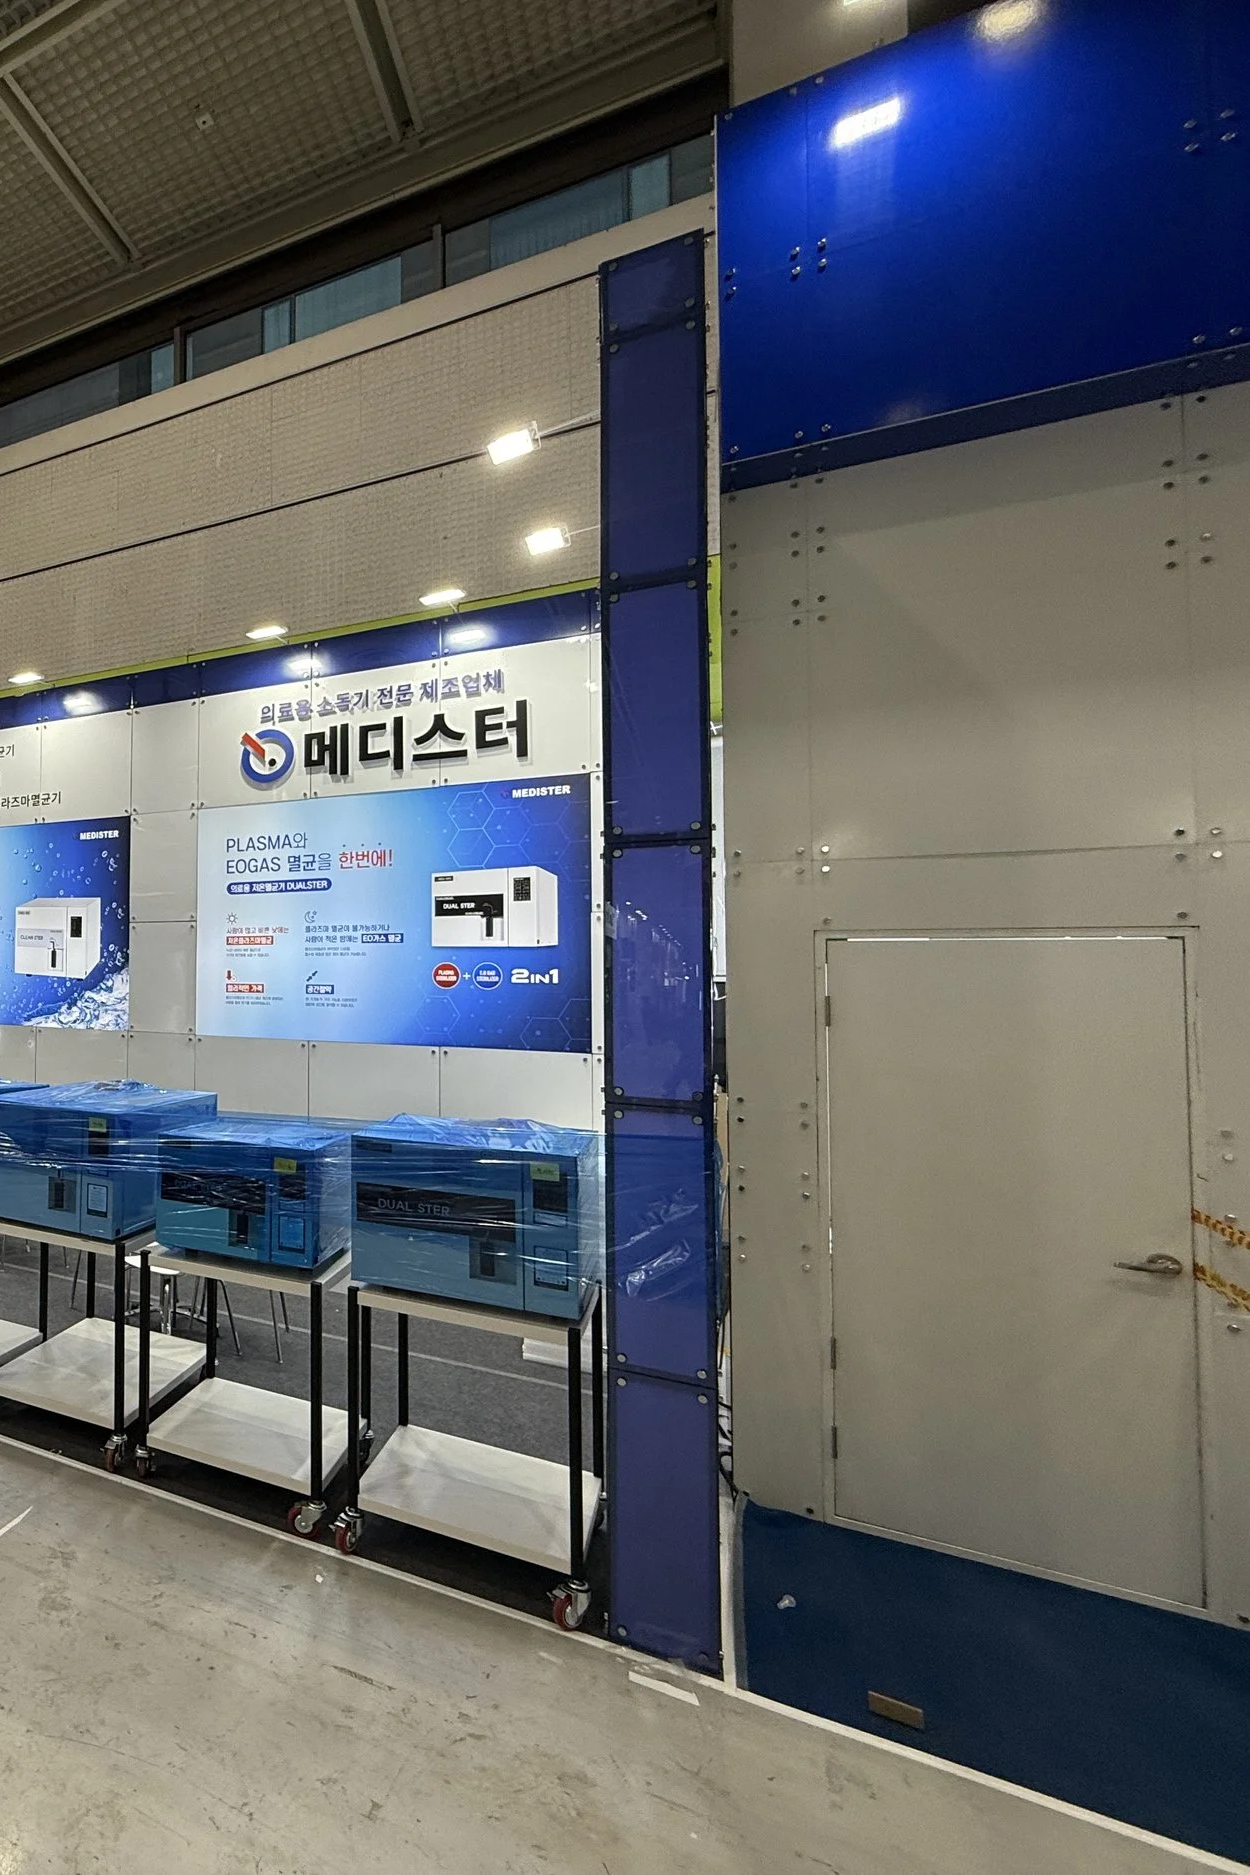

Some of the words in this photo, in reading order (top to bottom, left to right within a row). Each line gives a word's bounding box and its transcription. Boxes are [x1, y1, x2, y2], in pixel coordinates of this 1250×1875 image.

[260, 699, 312, 725] 의료용
[317, 689, 369, 714] 소독기
[377, 683, 414, 707] 전문
[420, 669, 504, 703] 제조업체
[304, 699, 528, 776] 메디스터
[511, 784, 571, 798] MEDISTER
[79, 830, 119, 840] MEDISTER
[226, 832, 308, 853] PLASMA와
[226, 856, 281, 874] EOGAS
[287, 852, 332, 873] 멸균을
[338, 849, 393, 869] 한번에!
[286, 880, 328, 890] DUALSTER
[377, 1198, 413, 1212] DUAL
[417, 1203, 450, 1217] STER
